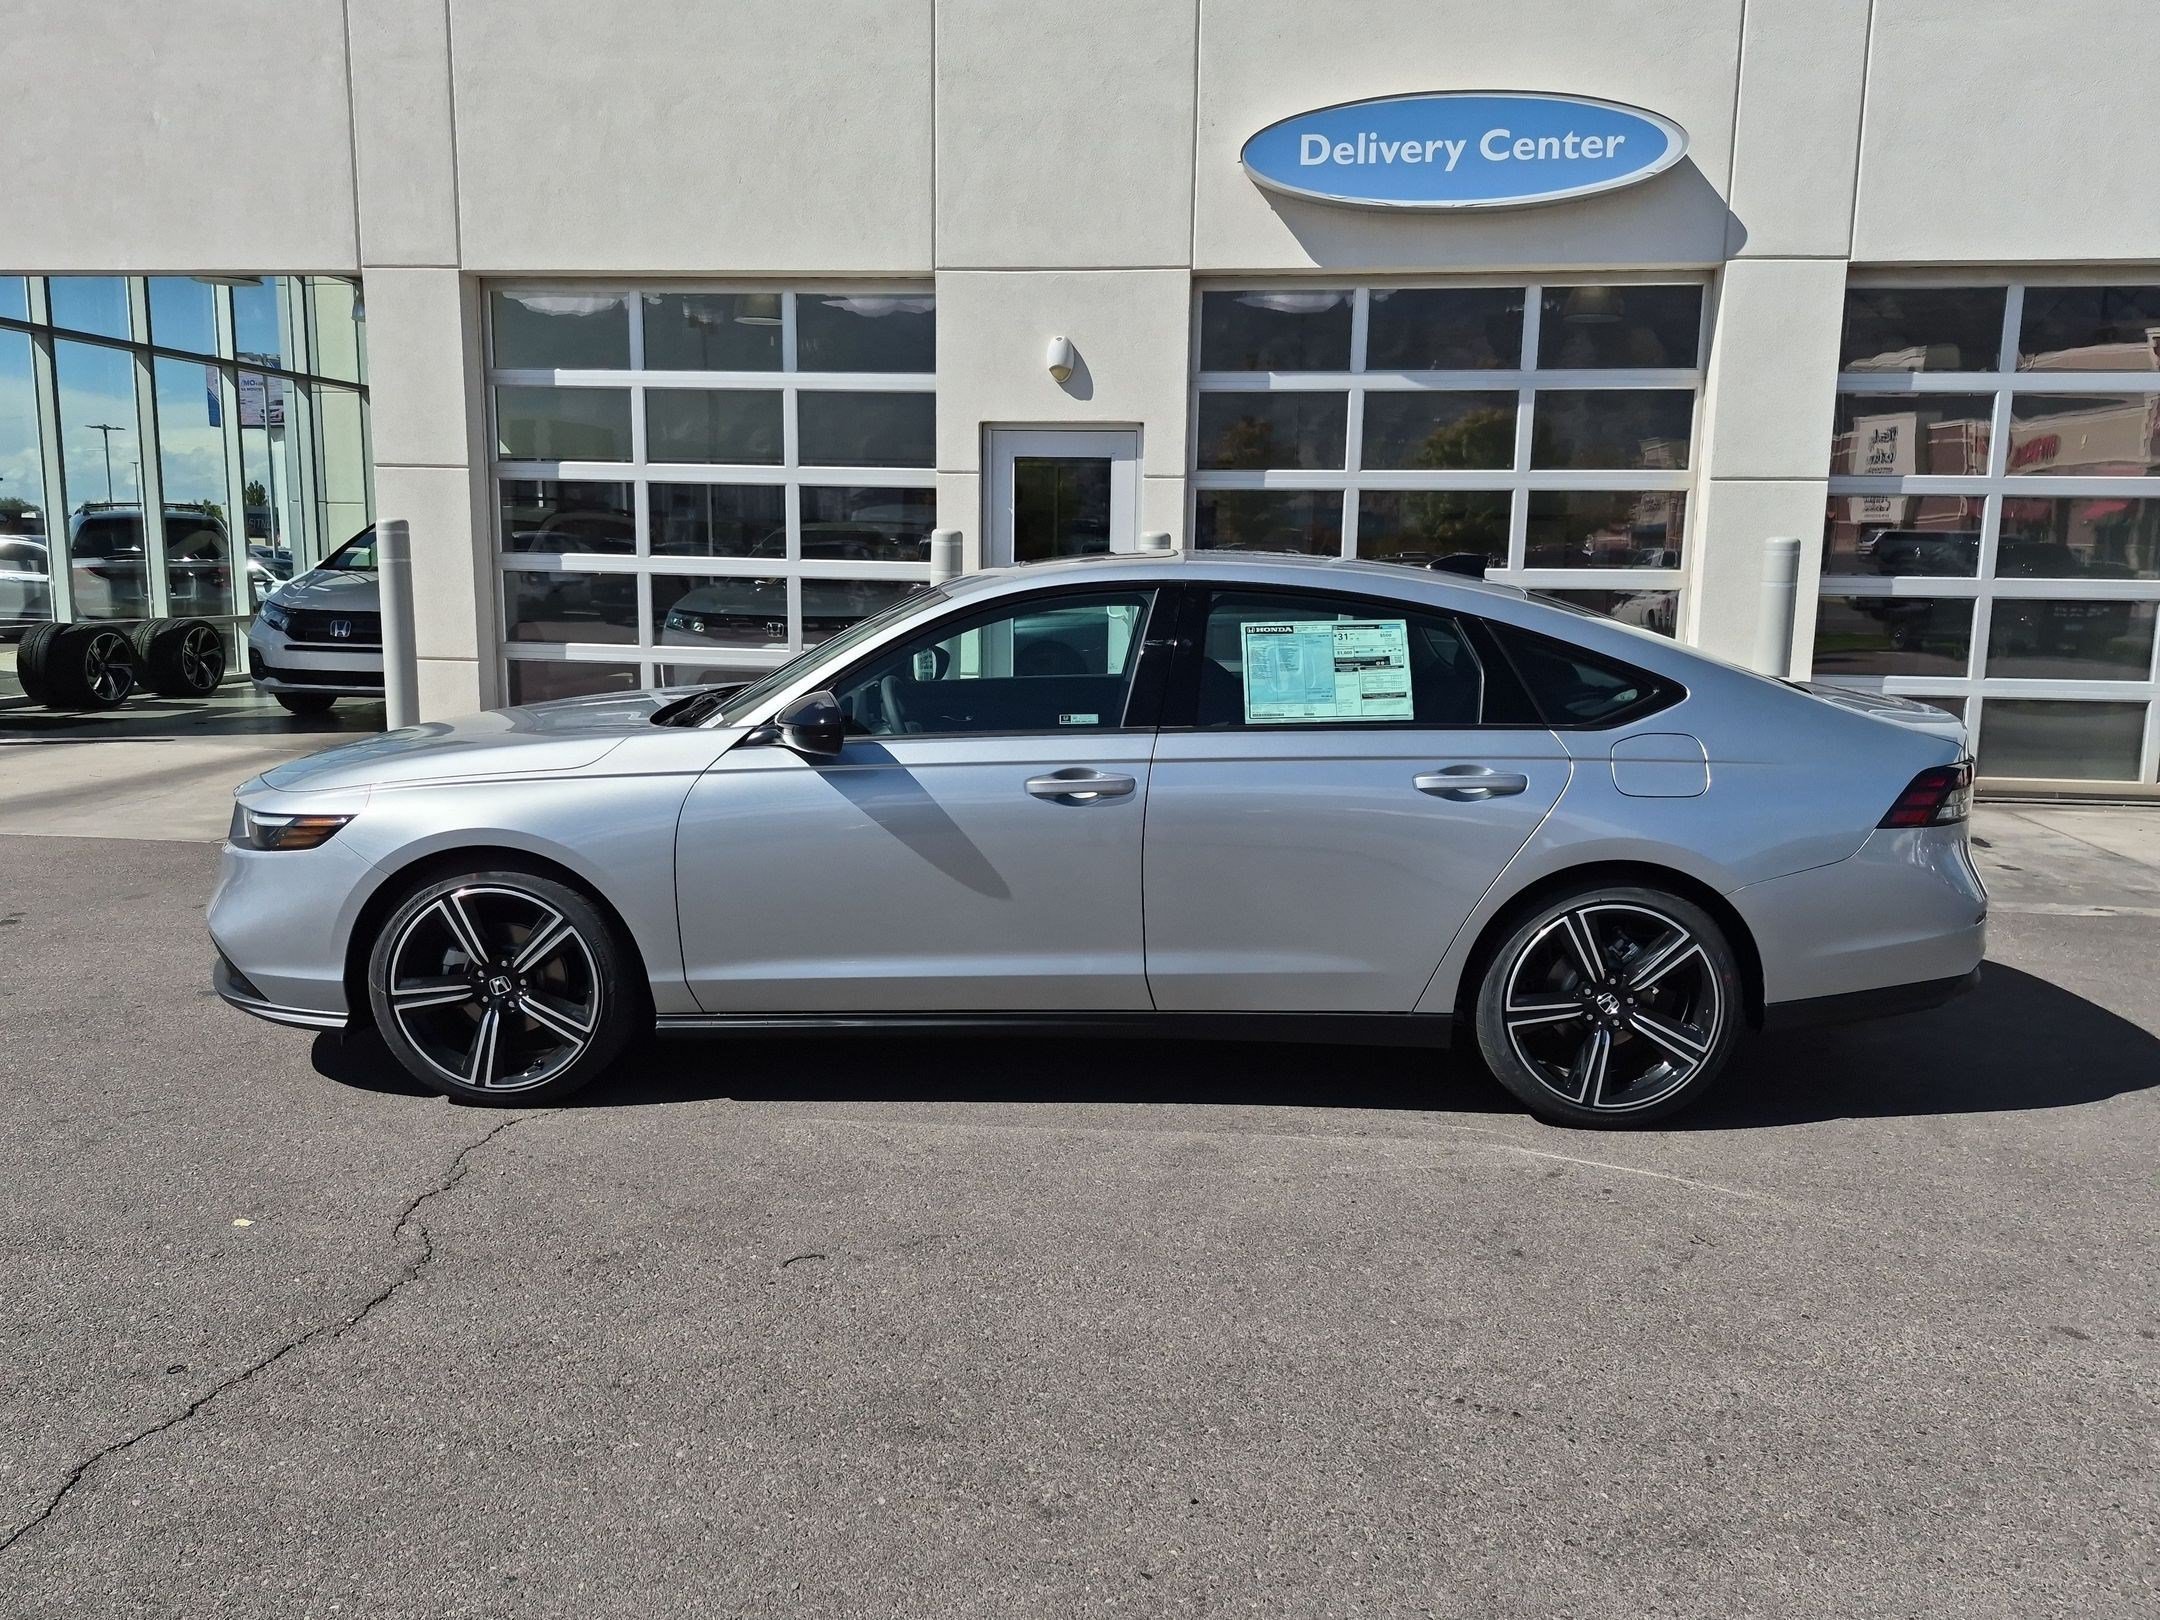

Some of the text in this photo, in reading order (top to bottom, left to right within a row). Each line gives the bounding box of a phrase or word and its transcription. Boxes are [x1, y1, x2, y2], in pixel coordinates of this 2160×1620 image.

[1299, 128, 1626, 172] Delivery Center
[1337, 632, 1349, 641] 31
